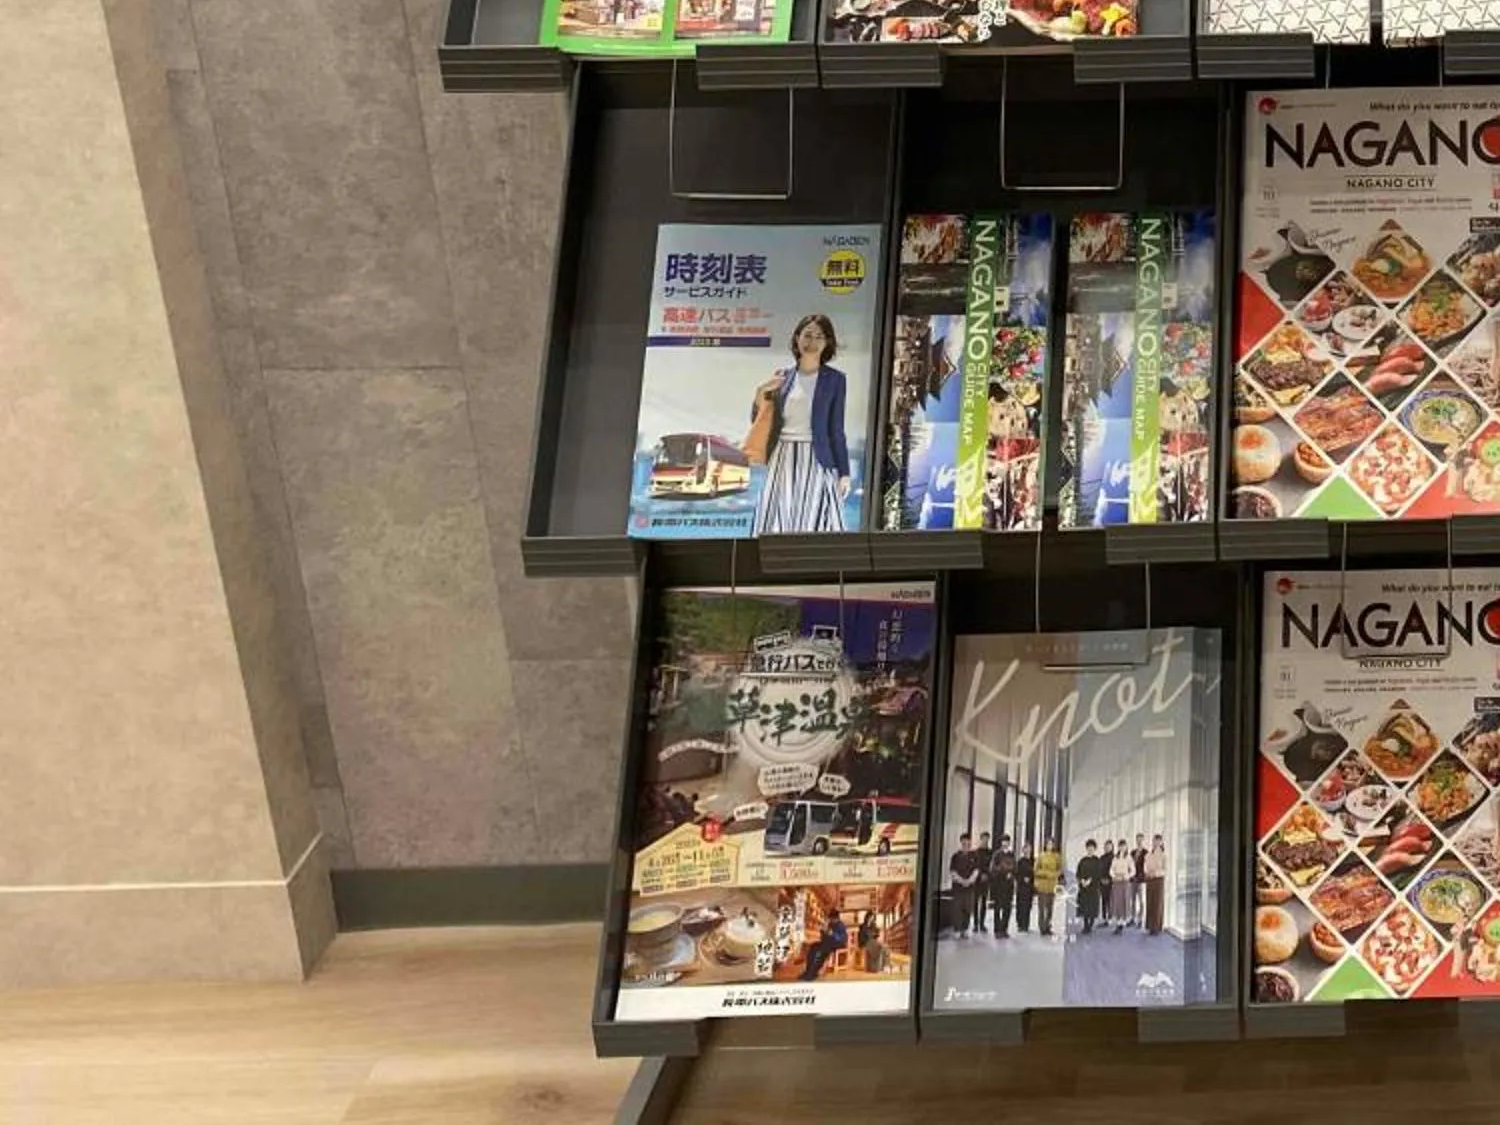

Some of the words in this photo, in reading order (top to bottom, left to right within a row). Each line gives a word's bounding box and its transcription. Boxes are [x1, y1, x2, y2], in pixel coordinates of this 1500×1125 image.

[1347, 178, 1404, 188] NAGANO
[1407, 177, 1436, 188] CITY
[665, 252, 768, 284] 時刻表
[827, 259, 860, 276] 無料
[664, 286, 750, 299] サービスガイド
[967, 220, 996, 360] NAGANO
[1136, 218, 1161, 357] NAGANO
[663, 307, 731, 324] 高速バス
[962, 412, 974, 445] MAP
[1134, 409, 1146, 441] MAP
[726, 685, 873, 746] 草津温泉
[948, 635, 1218, 768] Knot
